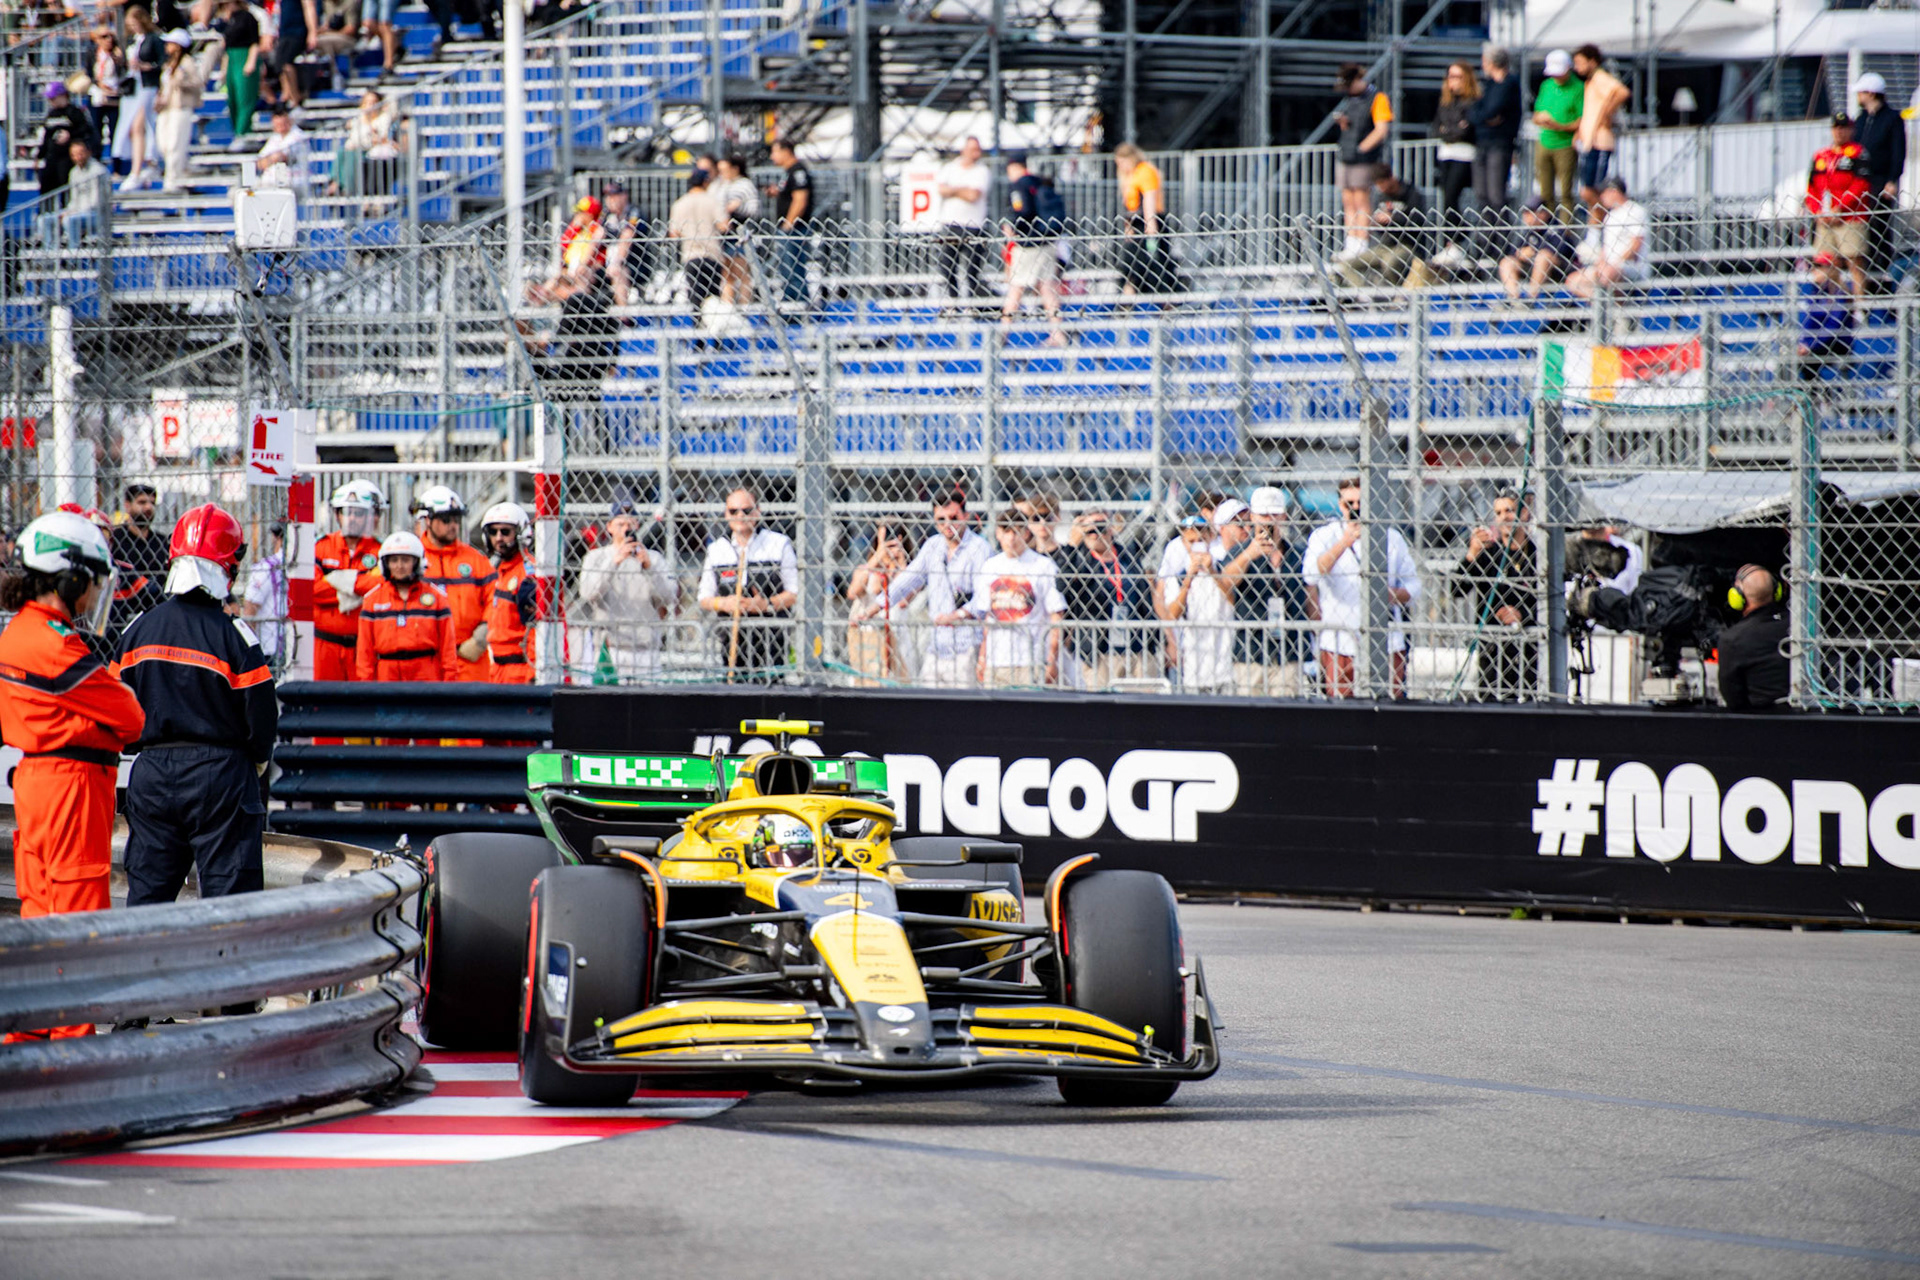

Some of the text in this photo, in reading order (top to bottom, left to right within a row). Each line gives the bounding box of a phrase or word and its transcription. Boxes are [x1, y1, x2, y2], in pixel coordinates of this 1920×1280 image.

[912, 190, 930, 221] P
[162, 416, 180, 446] P
[251, 452, 285, 461] FIRE
[579, 756, 684, 788] OKX
[1532, 758, 1920, 870] #Mona
[823, 892, 875, 910] 4
